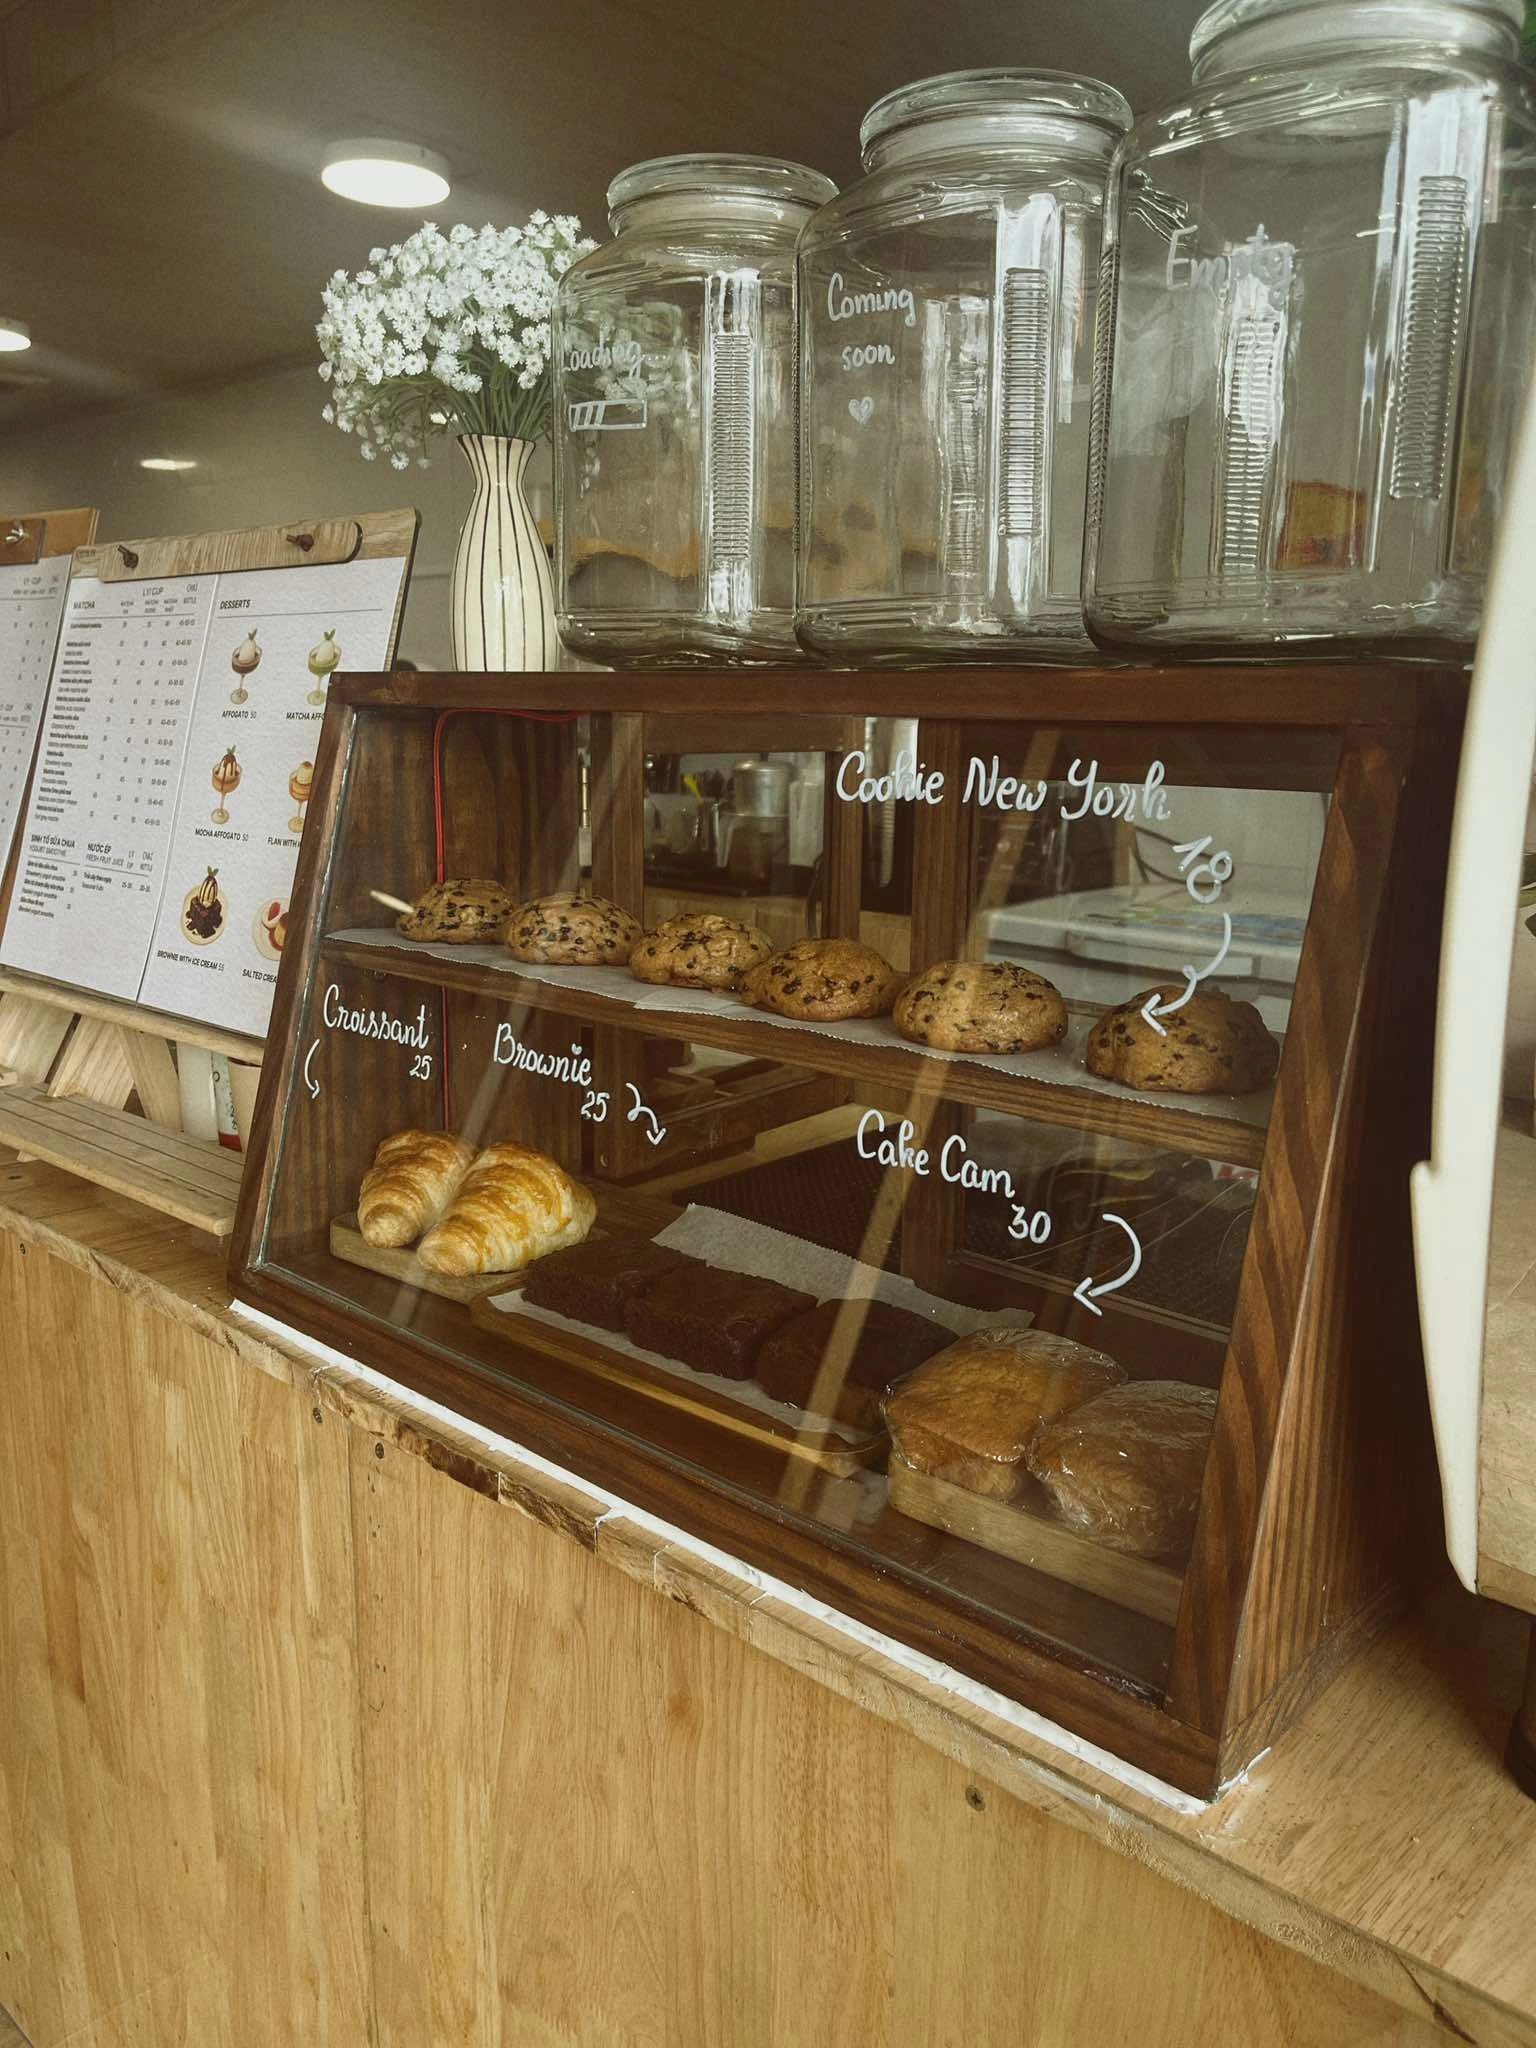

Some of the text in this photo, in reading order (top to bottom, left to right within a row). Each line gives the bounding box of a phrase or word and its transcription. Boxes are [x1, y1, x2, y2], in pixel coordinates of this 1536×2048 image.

[827, 271, 916, 327] Coming
[841, 341, 895, 371] soon
[219, 599, 251, 610] DESSERTS
[221, 710, 249, 719] AFFOGATO
[286, 711, 310, 720] MATCHA
[836, 749, 1171, 824] Cookie New York
[195, 827, 214, 837] MOCHA
[214, 830, 241, 841] AFFOGATO
[267, 836, 282, 846] FLAN
[282, 838, 297, 848] WITH
[1172, 834, 1234, 905] 18
[157, 949, 179, 962] BROWNIE
[179, 952, 192, 965] WITH
[192, 956, 200, 966] ICE
[200, 958, 218, 970] CREAM
[242, 968, 263, 980] SALTED
[322, 983, 429, 1050] Croissant
[409, 1054, 433, 1081] 25
[493, 1022, 593, 1087] Brownie
[580, 1090, 611, 1123] 25
[856, 1108, 1016, 1199] Cake Cam
[1007, 1203, 1051, 1245] 30
